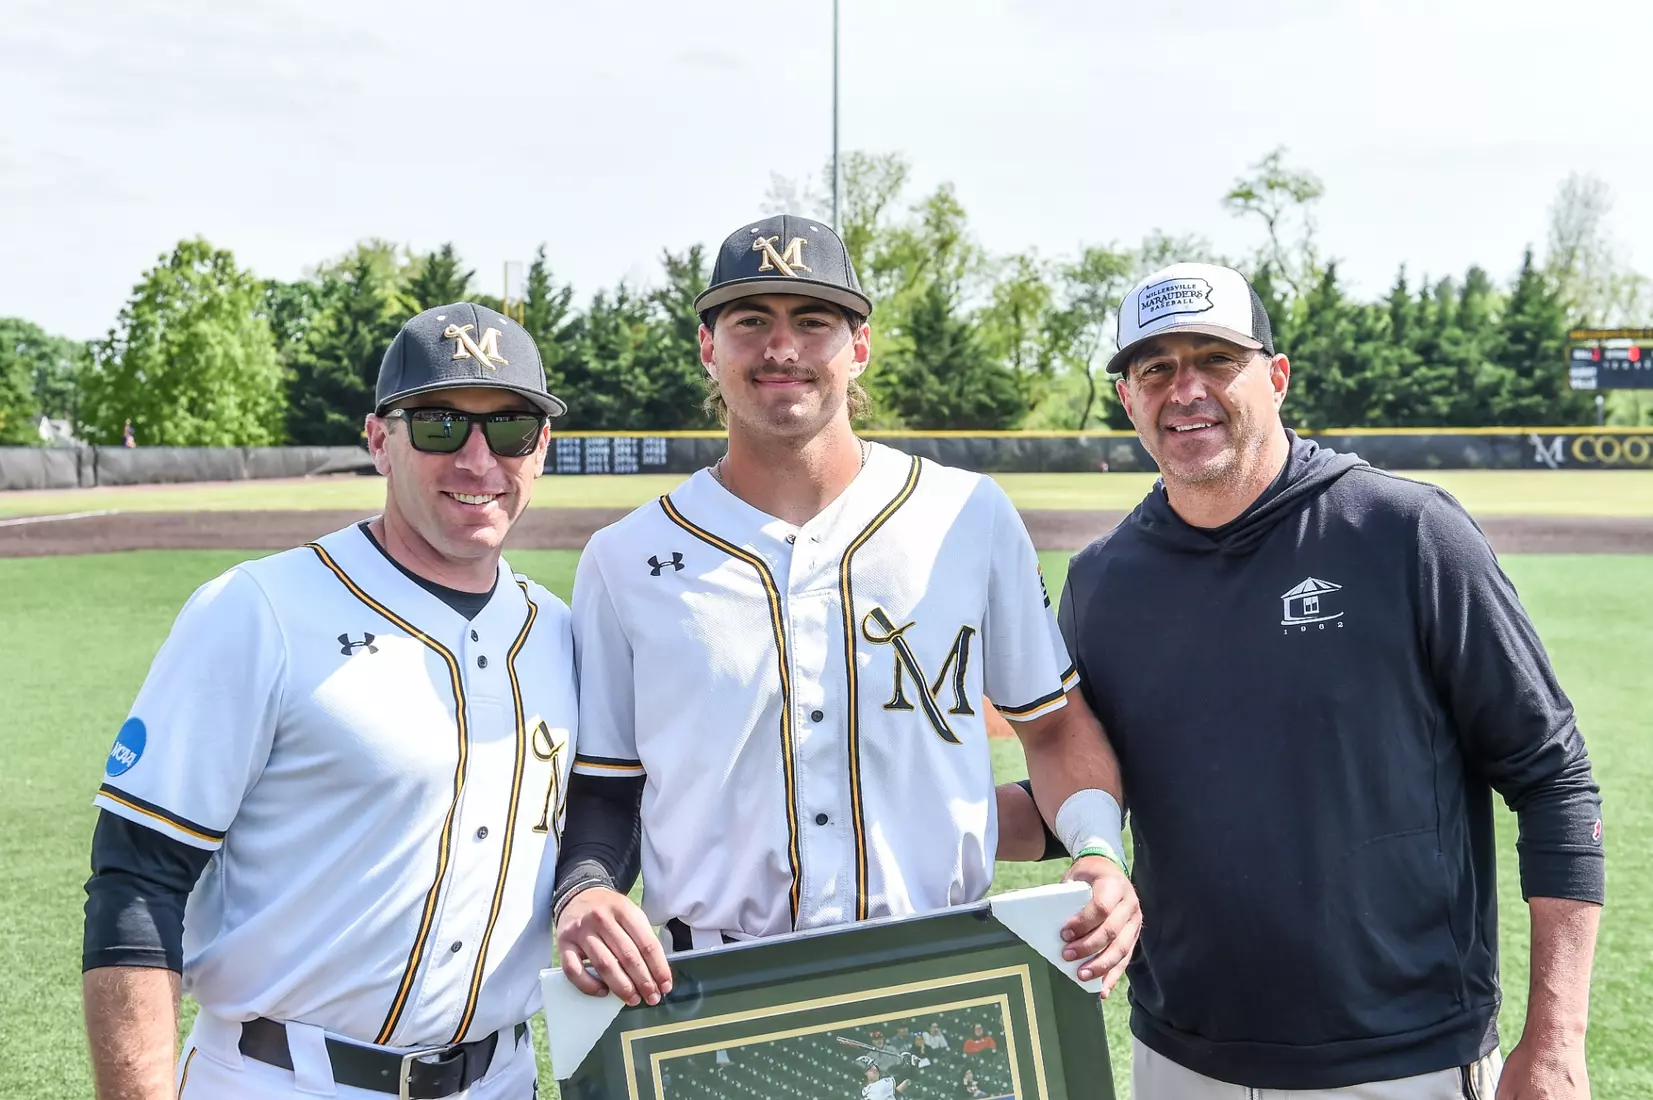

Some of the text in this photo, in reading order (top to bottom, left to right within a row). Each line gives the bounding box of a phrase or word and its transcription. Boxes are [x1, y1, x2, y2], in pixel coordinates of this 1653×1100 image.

[752, 235, 812, 278] M
[1140, 290, 1203, 311] MARAUDERS
[1145, 284, 1197, 300] MILLERSVILLE
[1150, 299, 1194, 313] BASEBALL
[443, 323, 509, 371] M
[861, 606, 977, 745] M
[110, 741, 138, 768] NCAA
